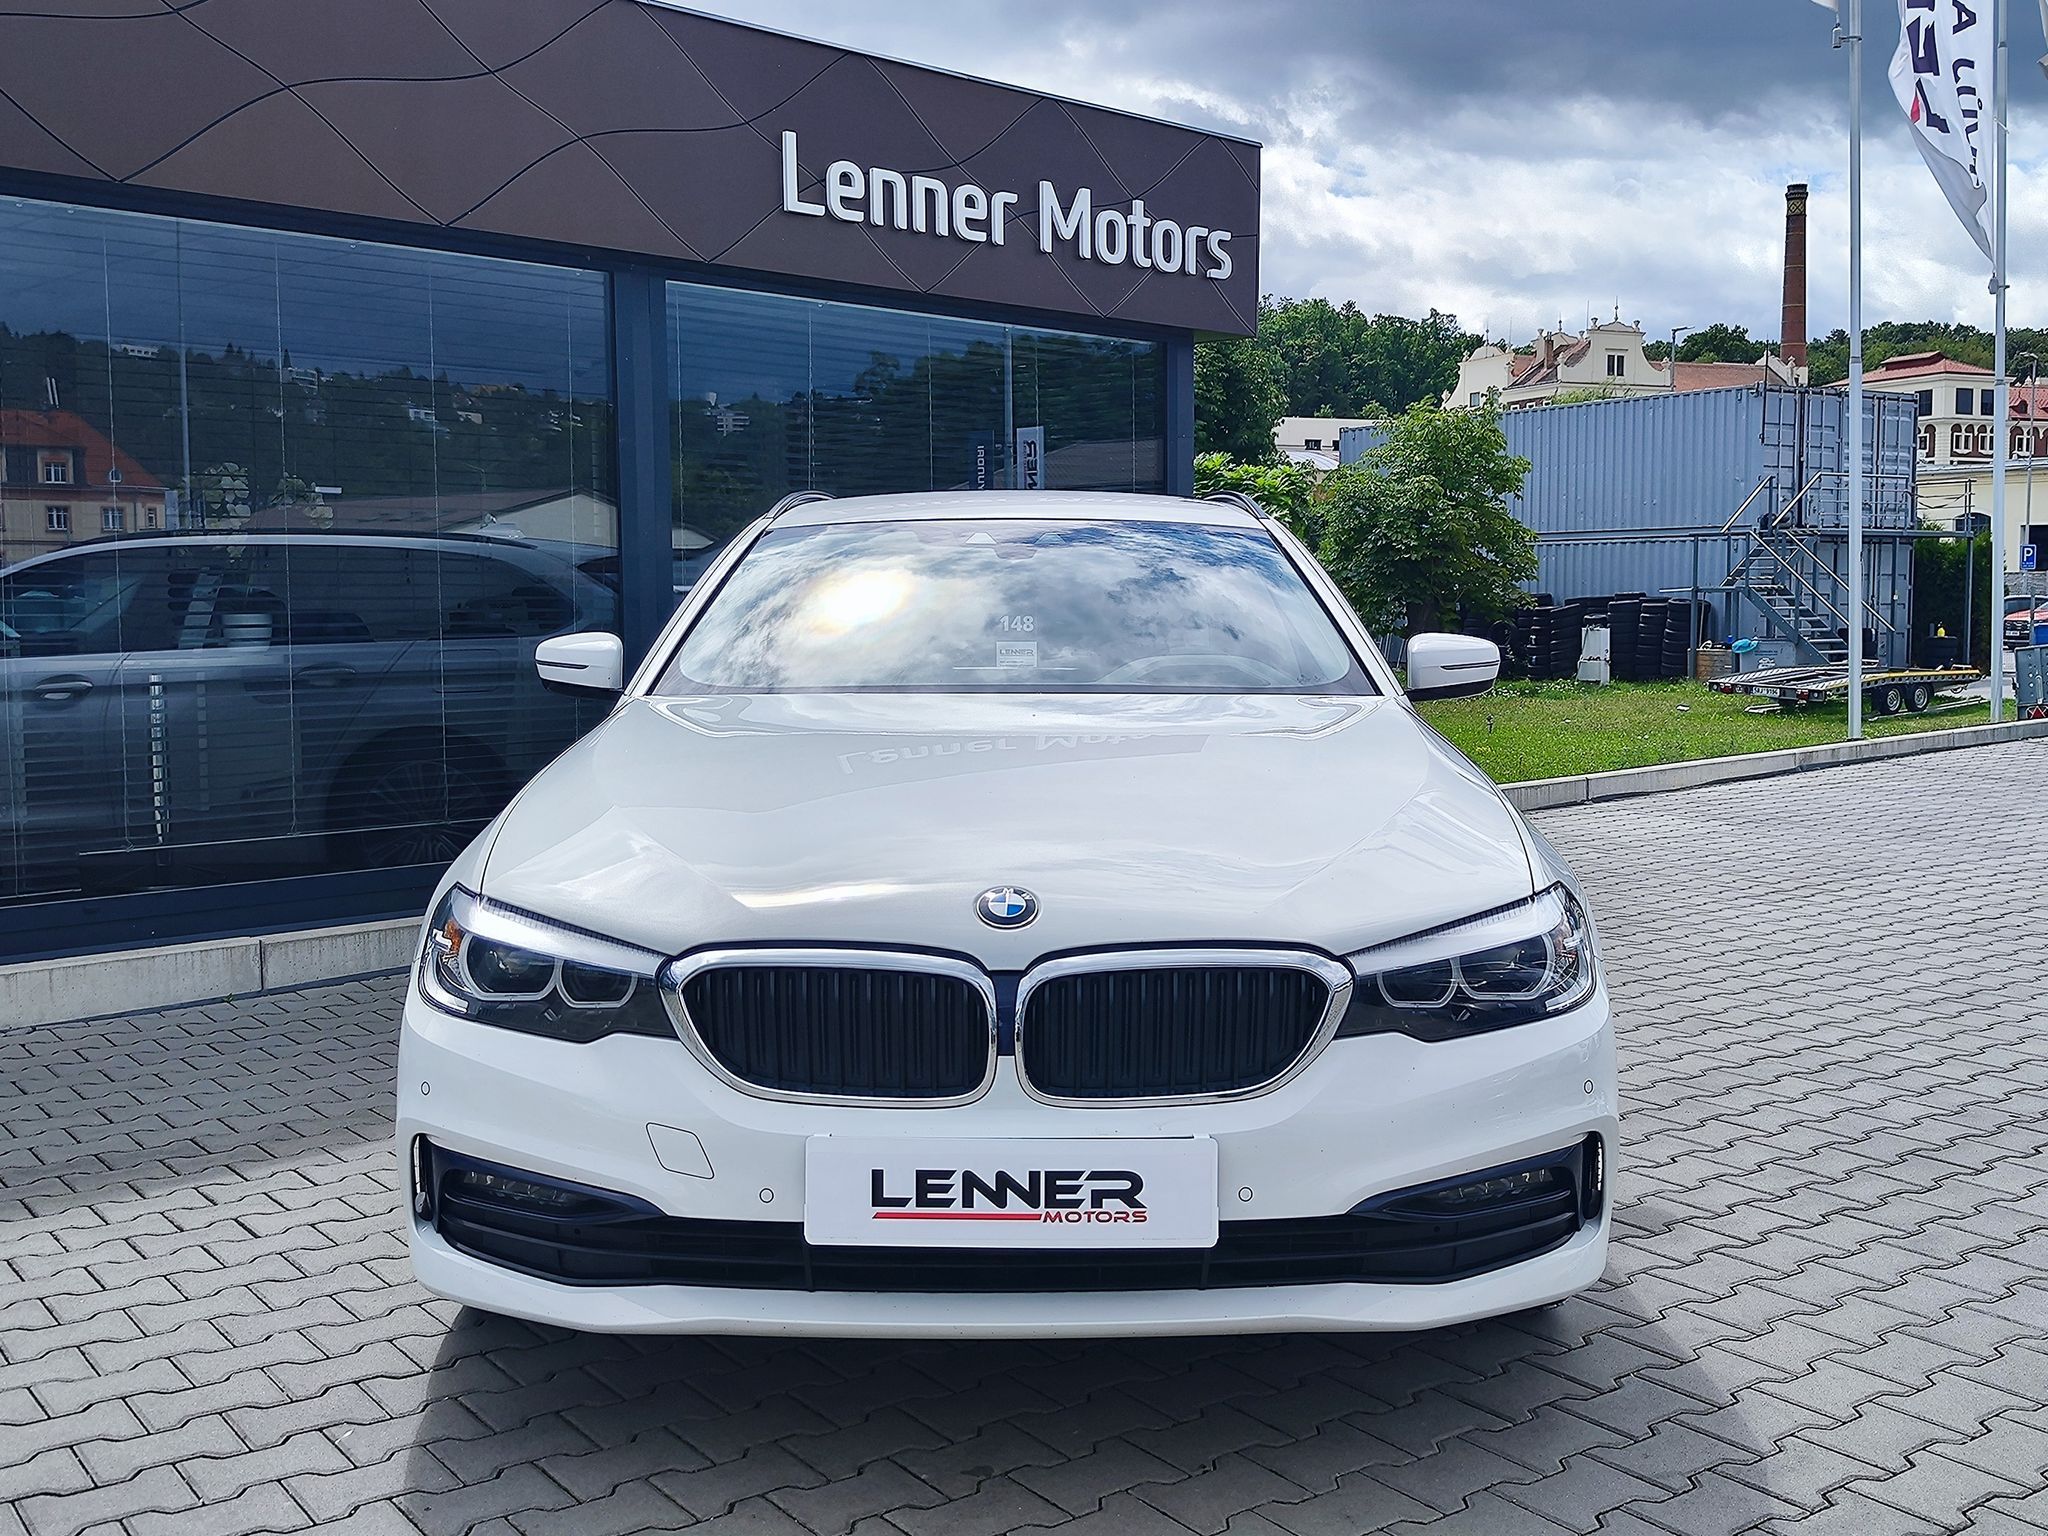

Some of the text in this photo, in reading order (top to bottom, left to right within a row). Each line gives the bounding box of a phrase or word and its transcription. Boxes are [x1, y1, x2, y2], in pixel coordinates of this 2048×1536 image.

[781, 130, 1234, 280] Lenner Motors
[999, 615, 1035, 632] 148
[871, 1168, 1148, 1209] LENNER
[1042, 1209, 1149, 1224] MOTORS
